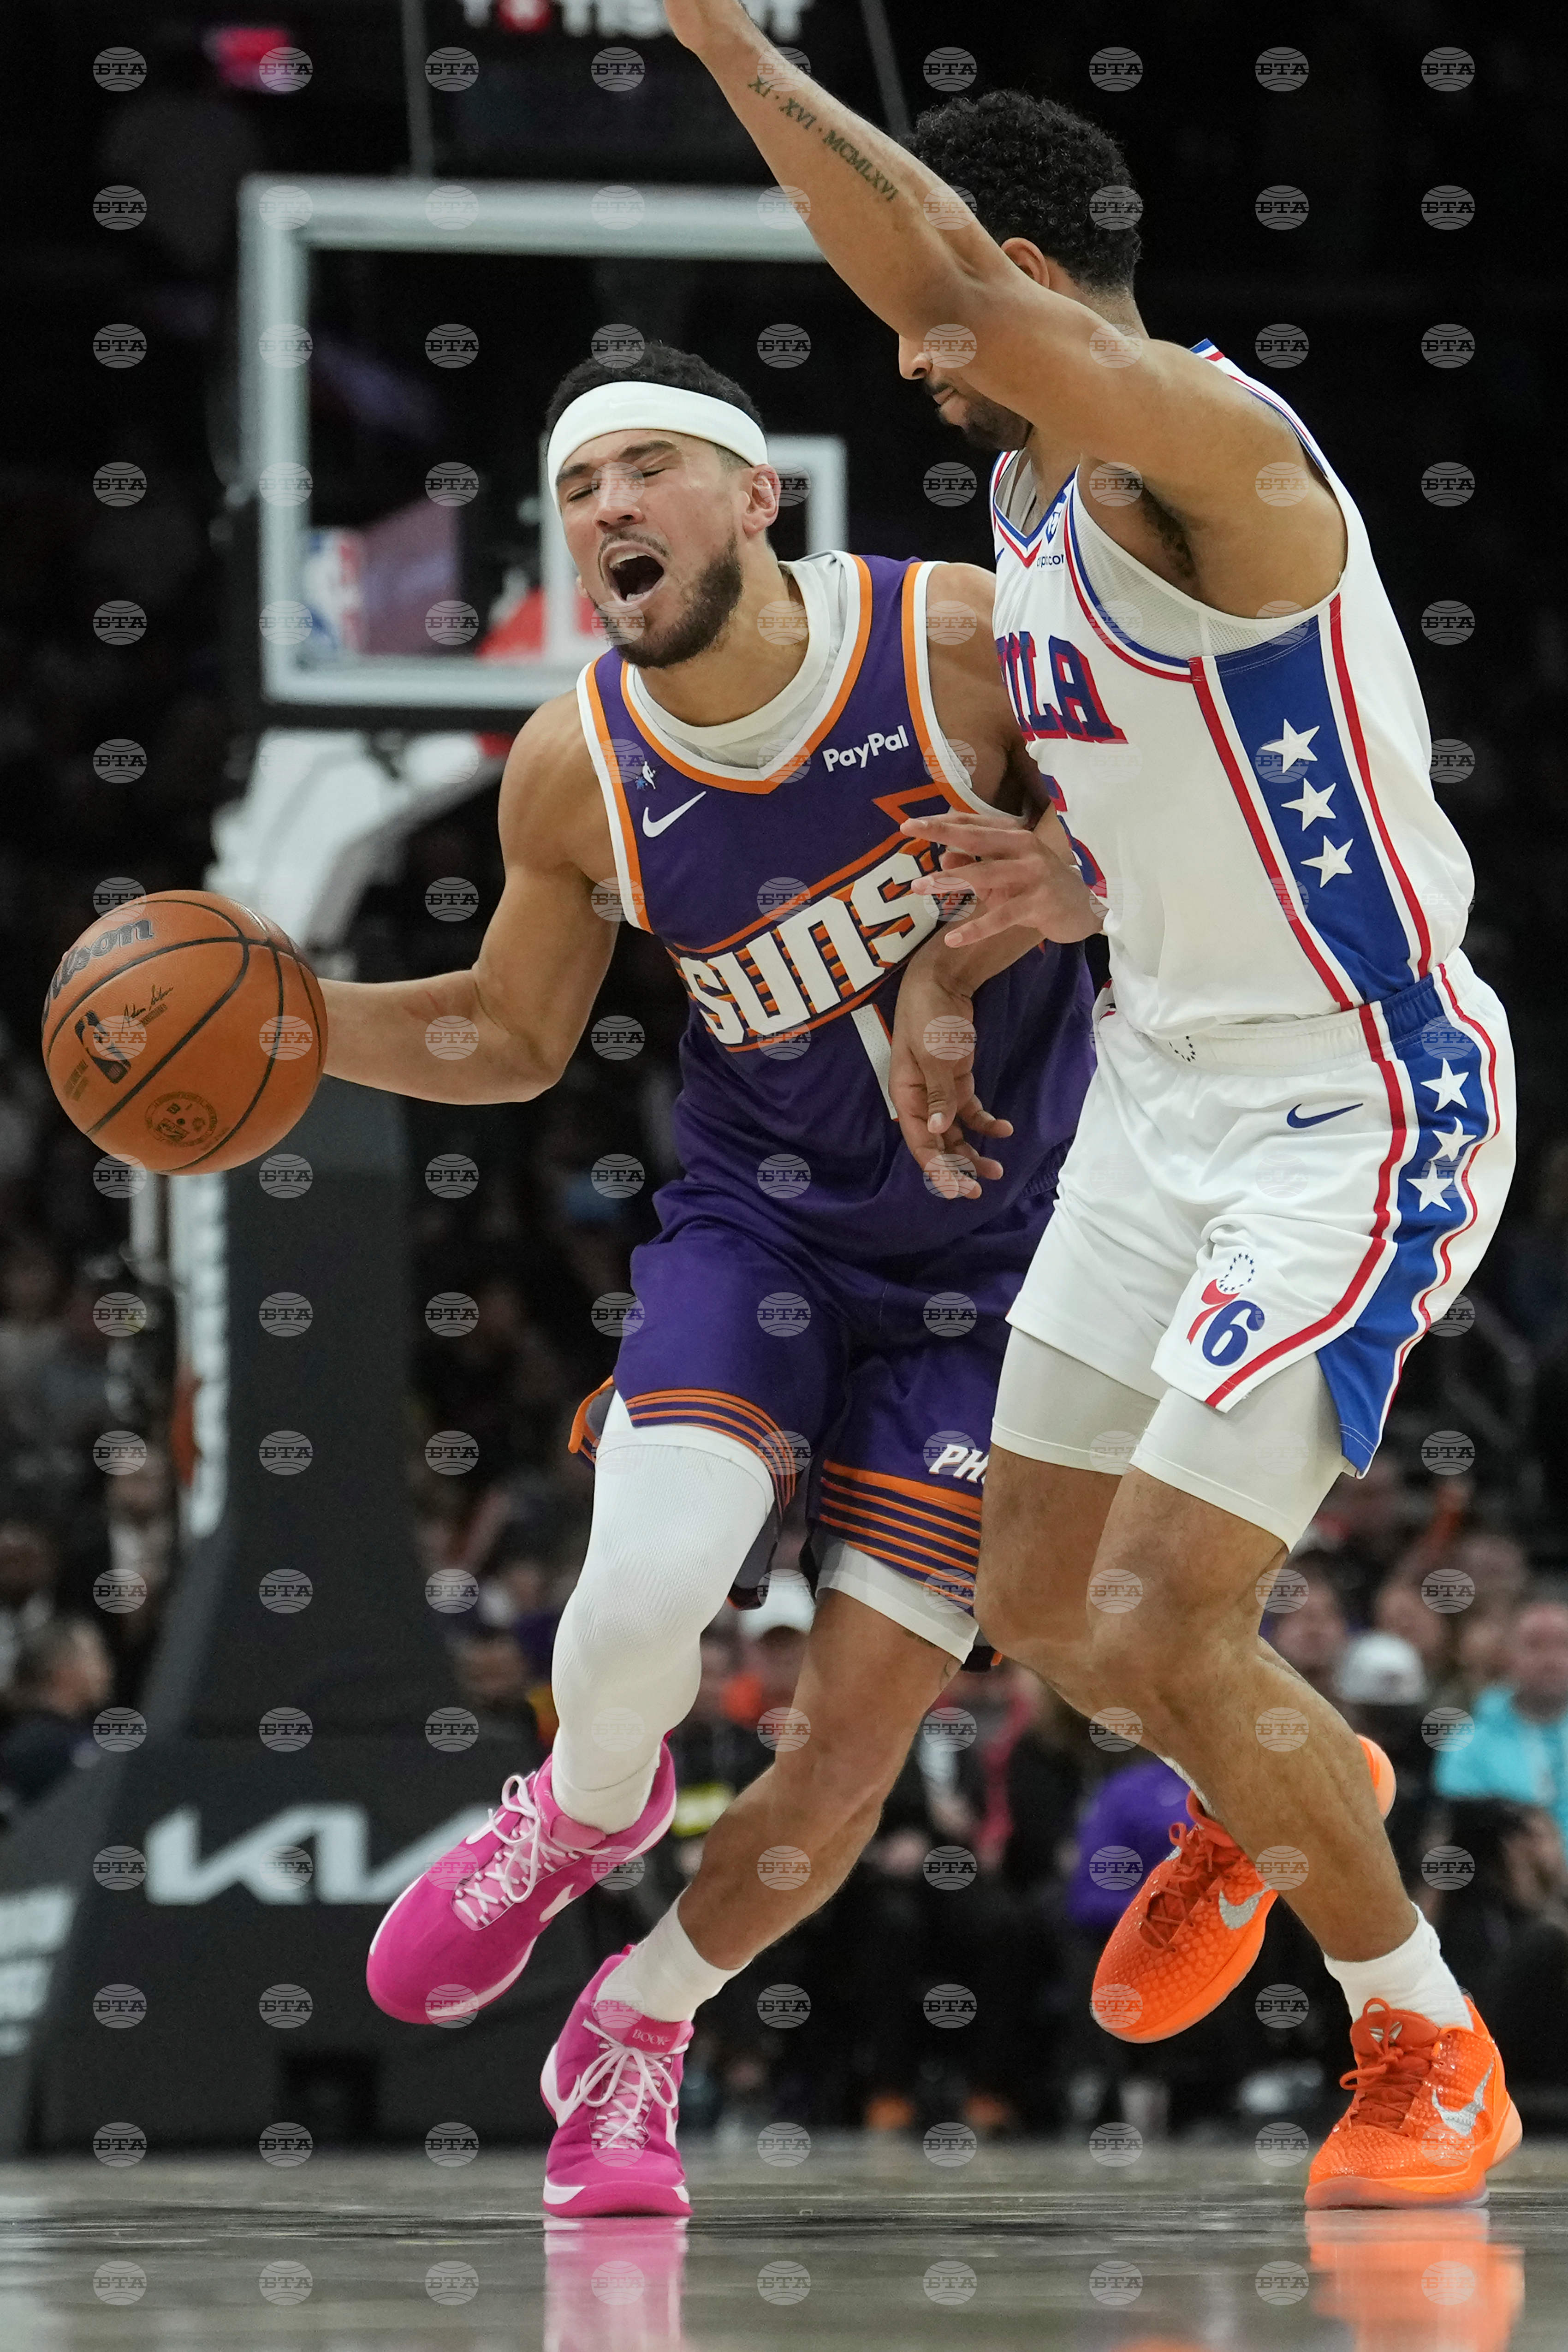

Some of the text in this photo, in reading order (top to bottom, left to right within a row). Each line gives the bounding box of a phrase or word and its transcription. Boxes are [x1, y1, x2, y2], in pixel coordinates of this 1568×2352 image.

[822, 725, 909, 773] PayPal
[679, 840, 944, 1045] SUNS
[1186, 1279, 1265, 1366] 76
[929, 1443, 988, 1484] PH
